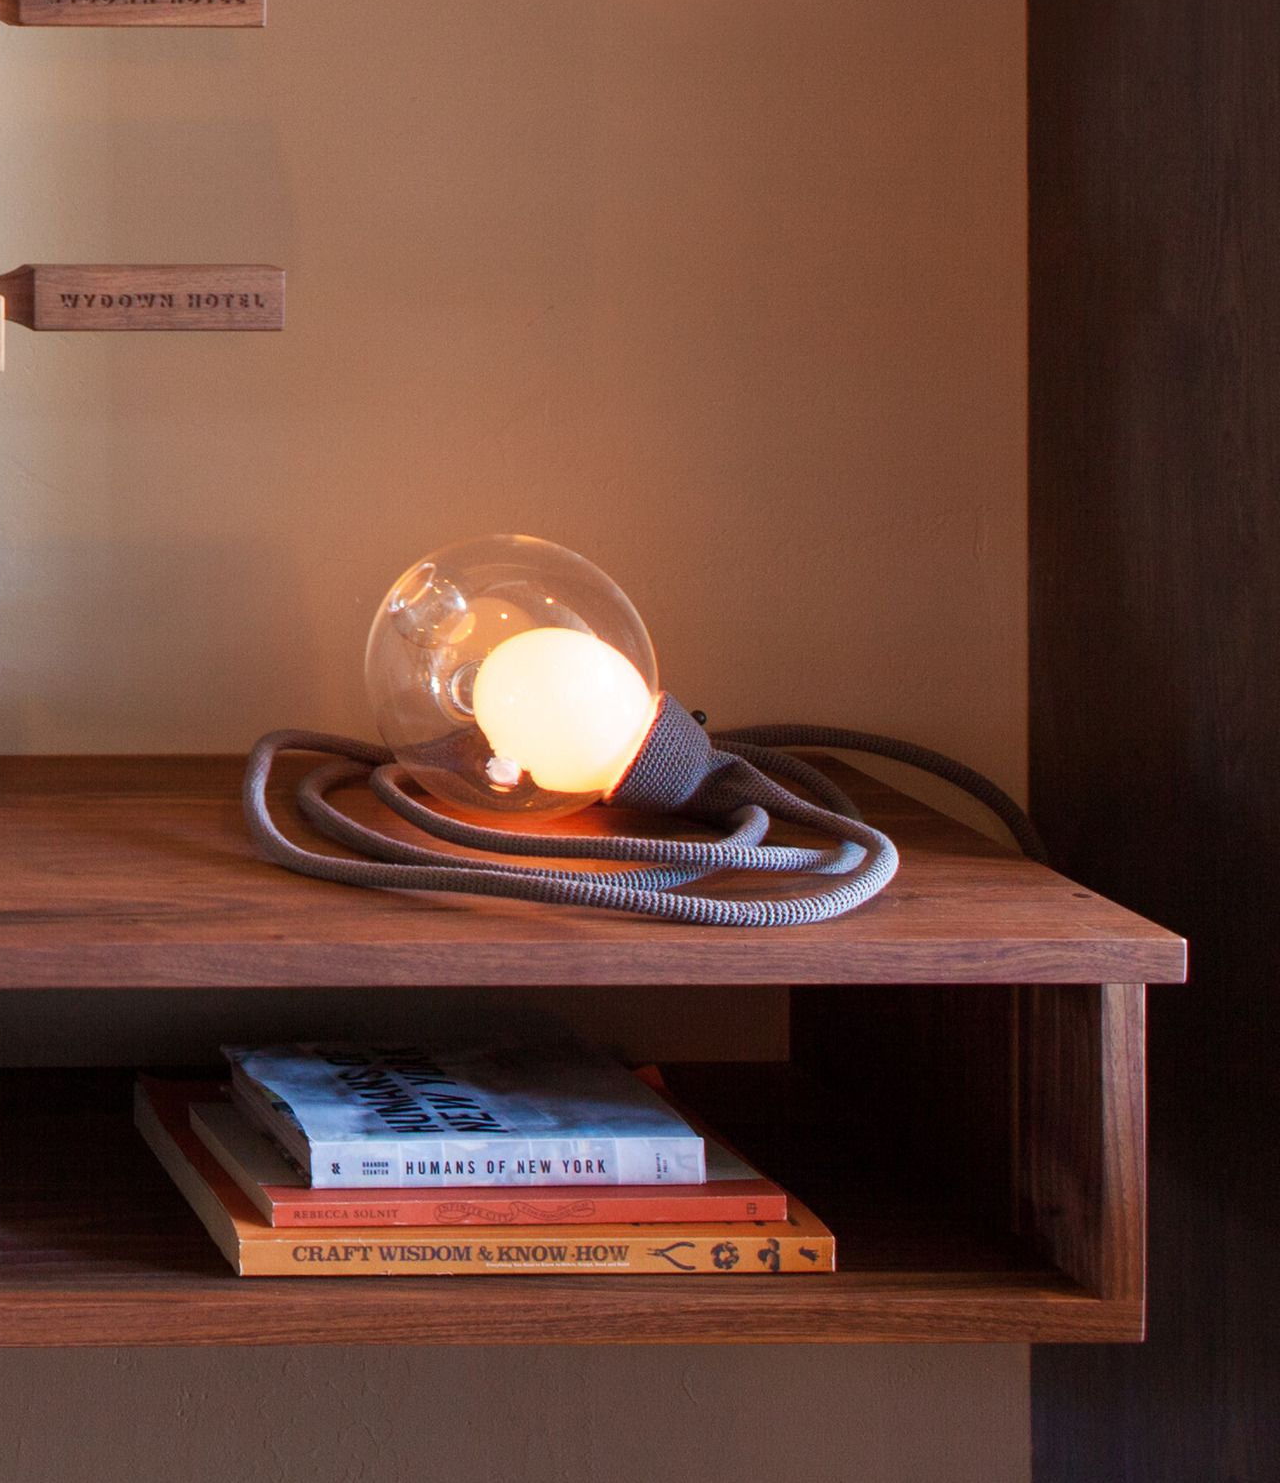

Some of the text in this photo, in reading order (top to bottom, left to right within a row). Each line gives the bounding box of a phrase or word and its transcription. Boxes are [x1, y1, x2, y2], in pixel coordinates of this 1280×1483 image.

[60, 293, 266, 309] WYDOWN HOTEL
[337, 1069, 445, 1133] HUMANS
[419, 1091, 511, 1133] NEW
[405, 1158, 607, 1175] HUMANS OF NEW YORK
[292, 1209, 348, 1220] REBECCA
[352, 1208, 399, 1219] SOLNIT
[292, 1245, 373, 1262] CRAFT
[377, 1244, 473, 1262] WISDOM
[476, 1245, 494, 1262] &
